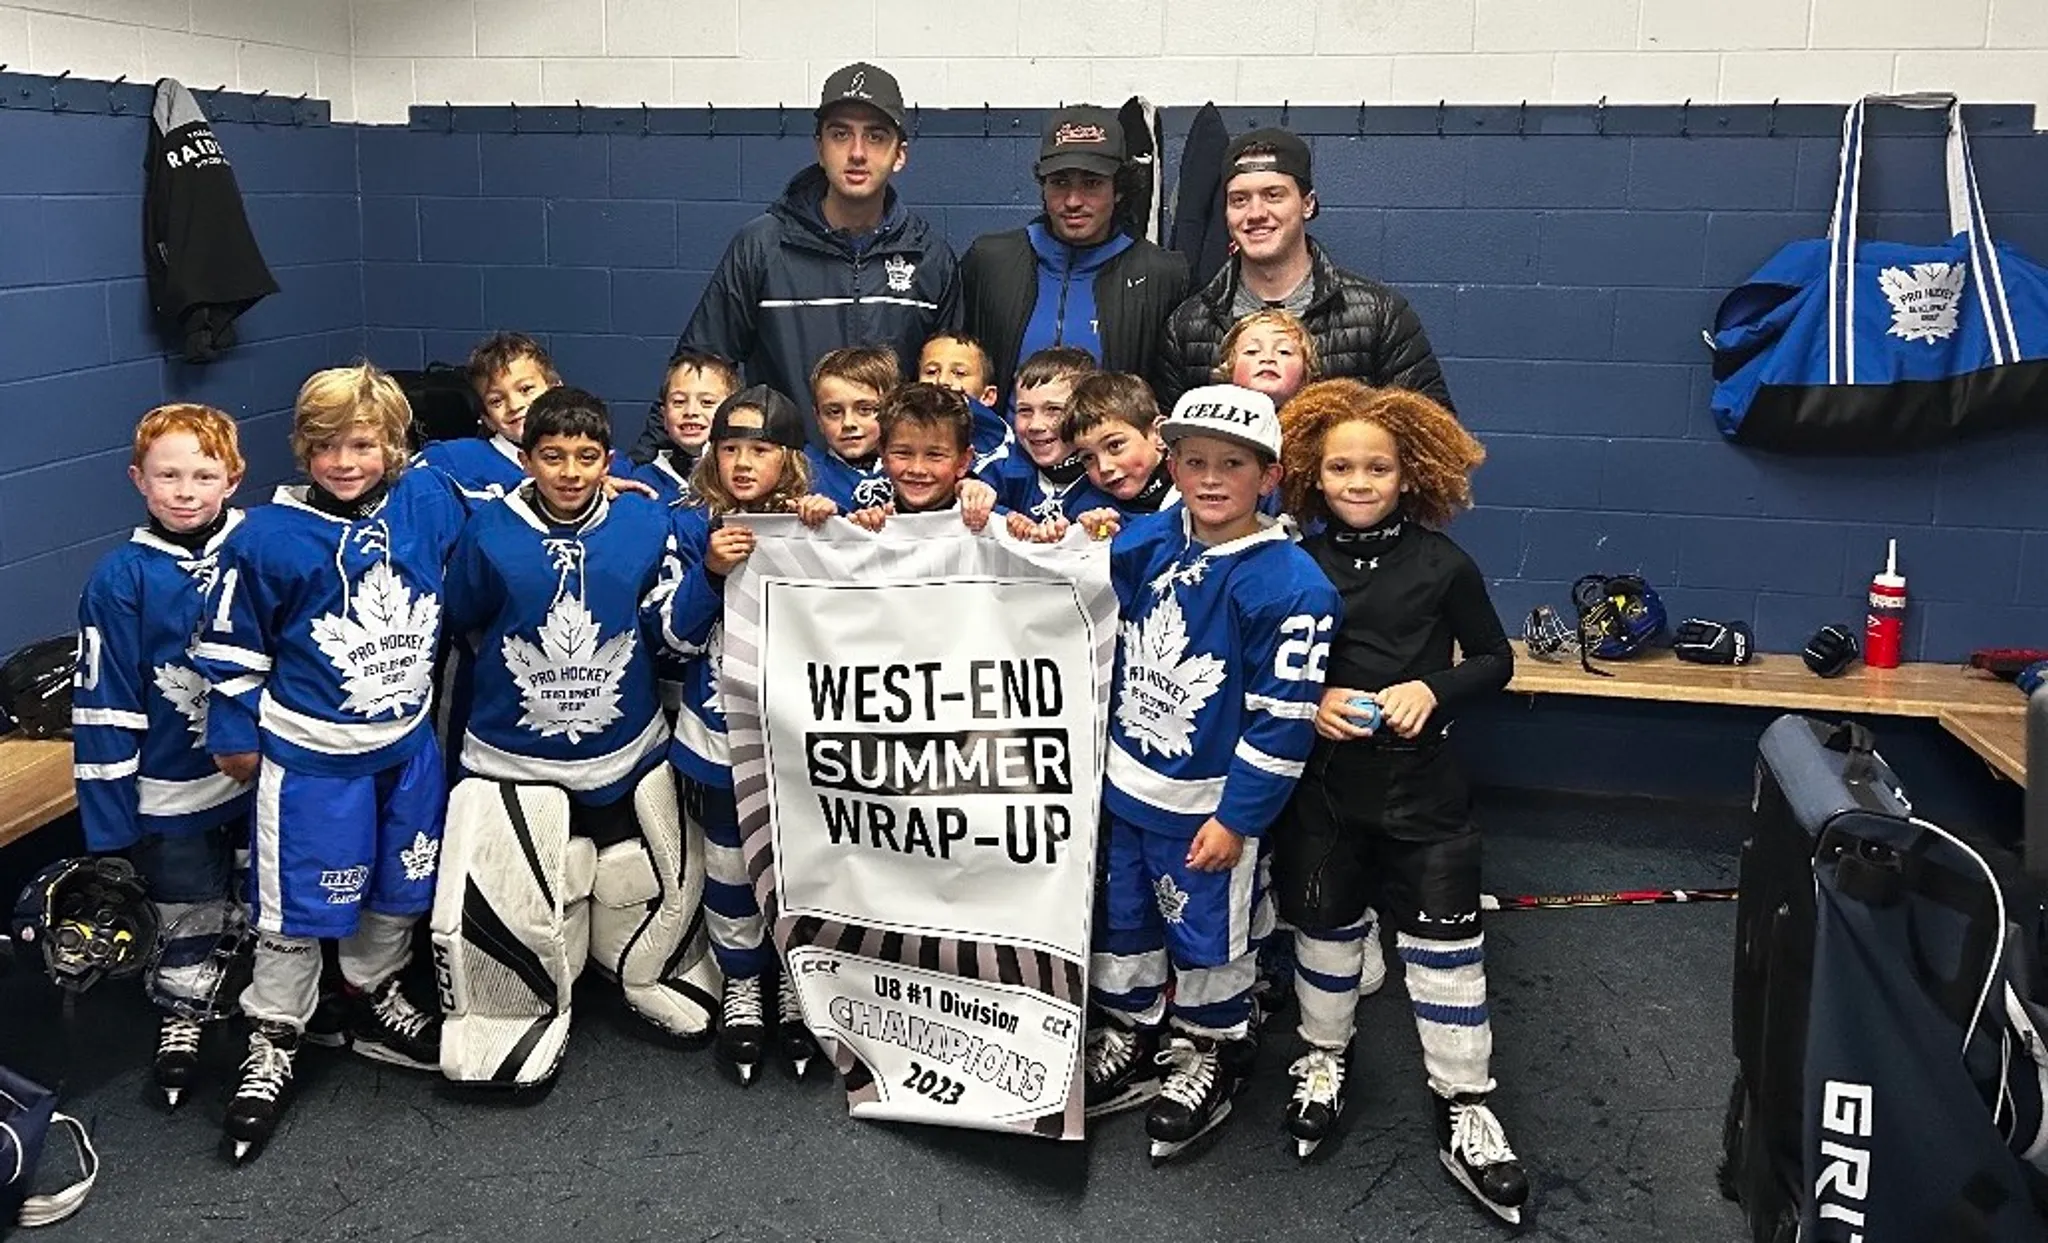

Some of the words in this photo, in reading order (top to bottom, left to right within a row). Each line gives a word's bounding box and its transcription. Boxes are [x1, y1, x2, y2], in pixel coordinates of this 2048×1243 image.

[1183, 404, 1260, 427] CELLY
[347, 641, 378, 666] PRO
[380, 634, 425, 652] HOCKEY
[529, 669, 556, 688] PRO
[560, 665, 612, 684] HOCKEY
[1274, 614, 1334, 684] 22
[807, 657, 1064, 723] WEST-END
[1147, 668, 1190, 706] HOCKEY
[812, 737, 1069, 789] SUMMER
[817, 793, 1072, 864] WRAP-UP
[432, 942, 456, 1012] CCM
[874, 974, 901, 1001] U8
[907, 982, 932, 1009] #1
[940, 990, 1020, 1034] Division
[829, 996, 1047, 1102] CHAMPIONS
[902, 1062, 966, 1105] 2023
